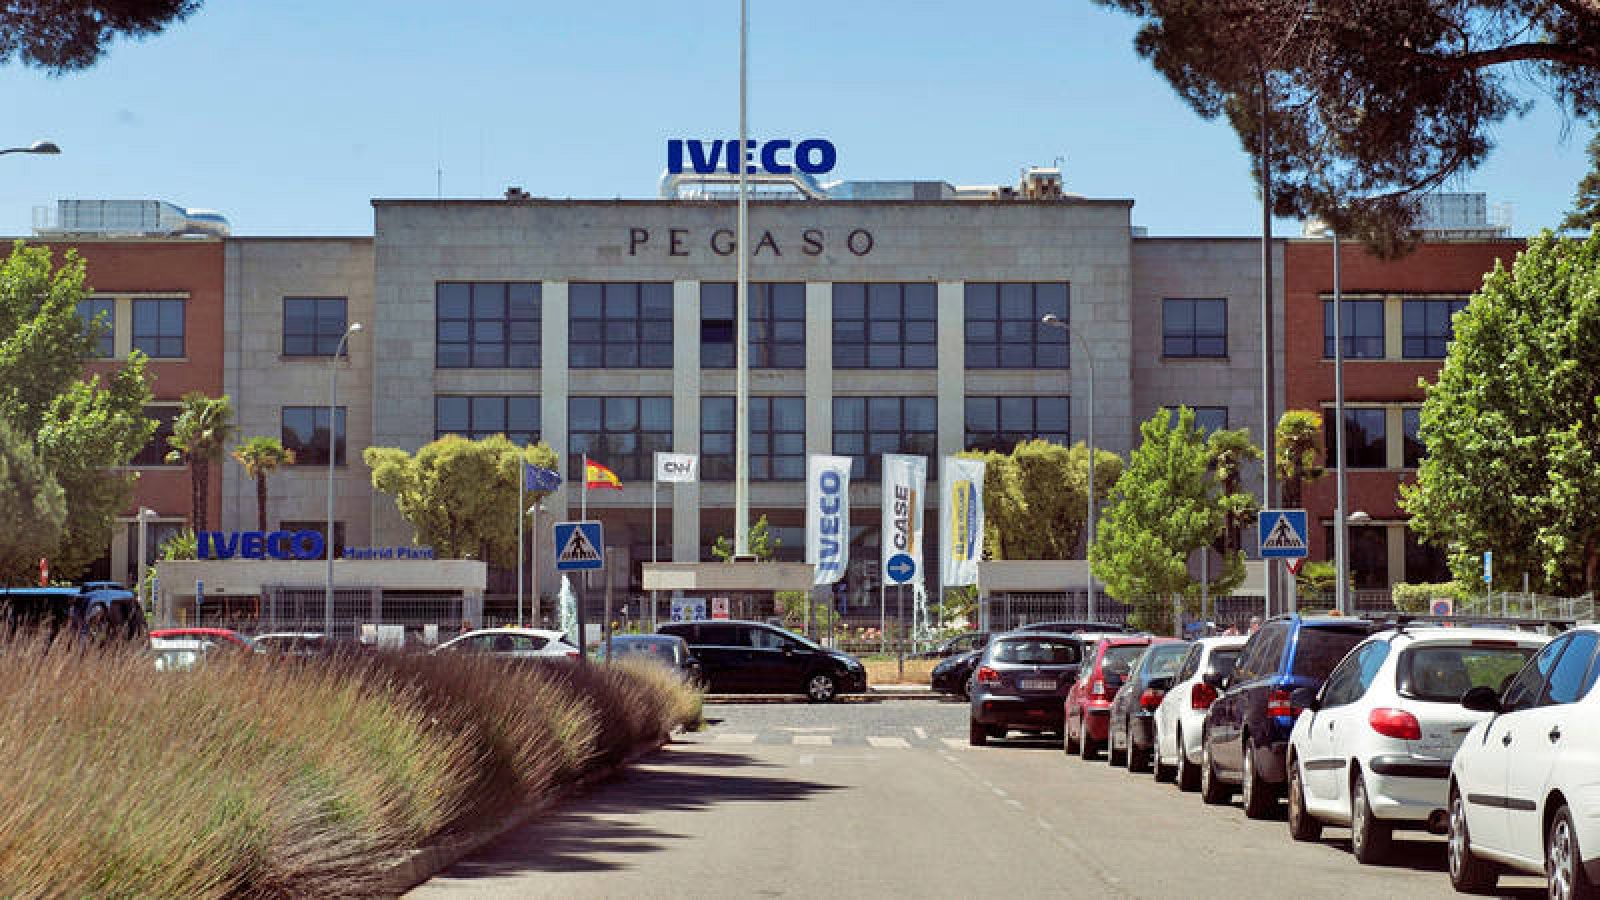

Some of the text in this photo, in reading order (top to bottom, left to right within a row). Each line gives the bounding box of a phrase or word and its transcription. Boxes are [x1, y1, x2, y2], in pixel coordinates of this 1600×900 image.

[667, 139, 837, 174] IVECO
[628, 227, 874, 257] PEGASO
[820, 471, 841, 570] IVECO
[894, 484, 908, 550] CASE
[197, 530, 324, 559] IVECO
[342, 545, 433, 559] Madrid Plant
